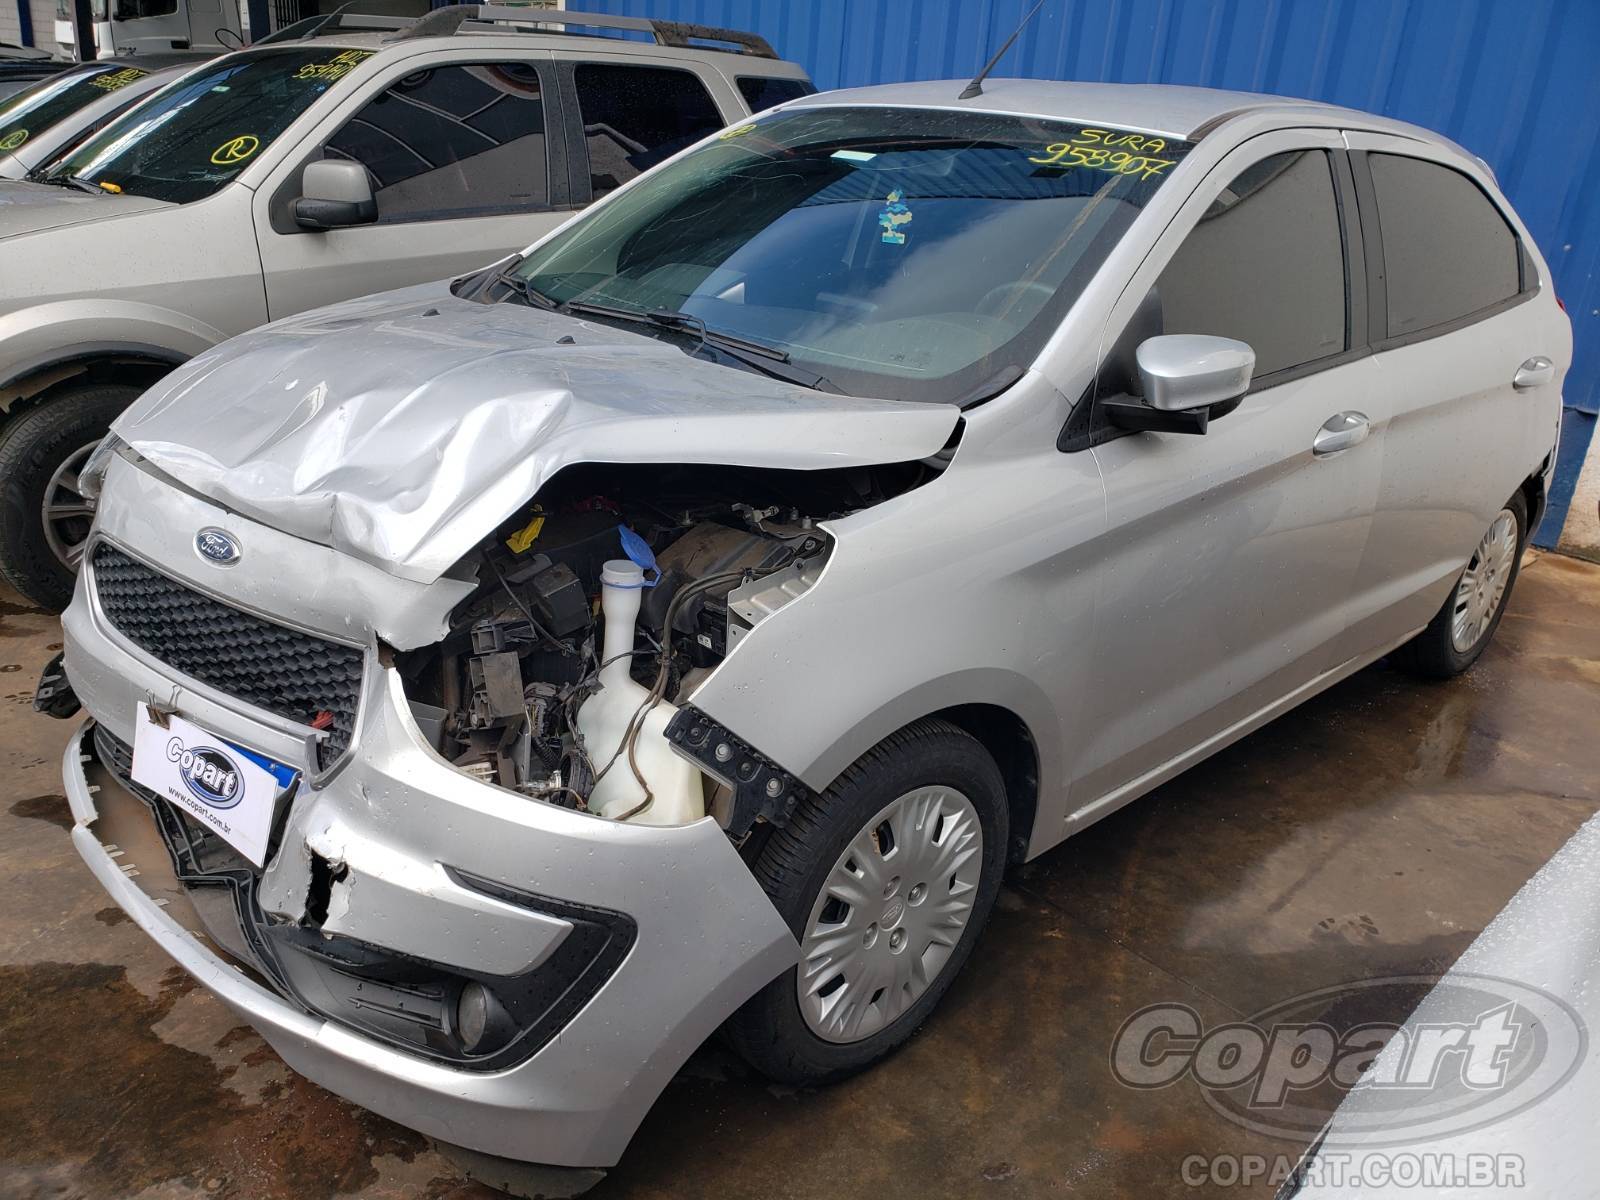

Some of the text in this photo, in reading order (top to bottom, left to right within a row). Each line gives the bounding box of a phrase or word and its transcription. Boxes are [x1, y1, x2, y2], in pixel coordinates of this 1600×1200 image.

[1071, 129, 1165, 153] SURA
[1028, 143, 1177, 181] 958907
[201, 535, 229, 556] Ford
[166, 737, 237, 797] Copart
[168, 786, 231, 835] www.copart.com.br
